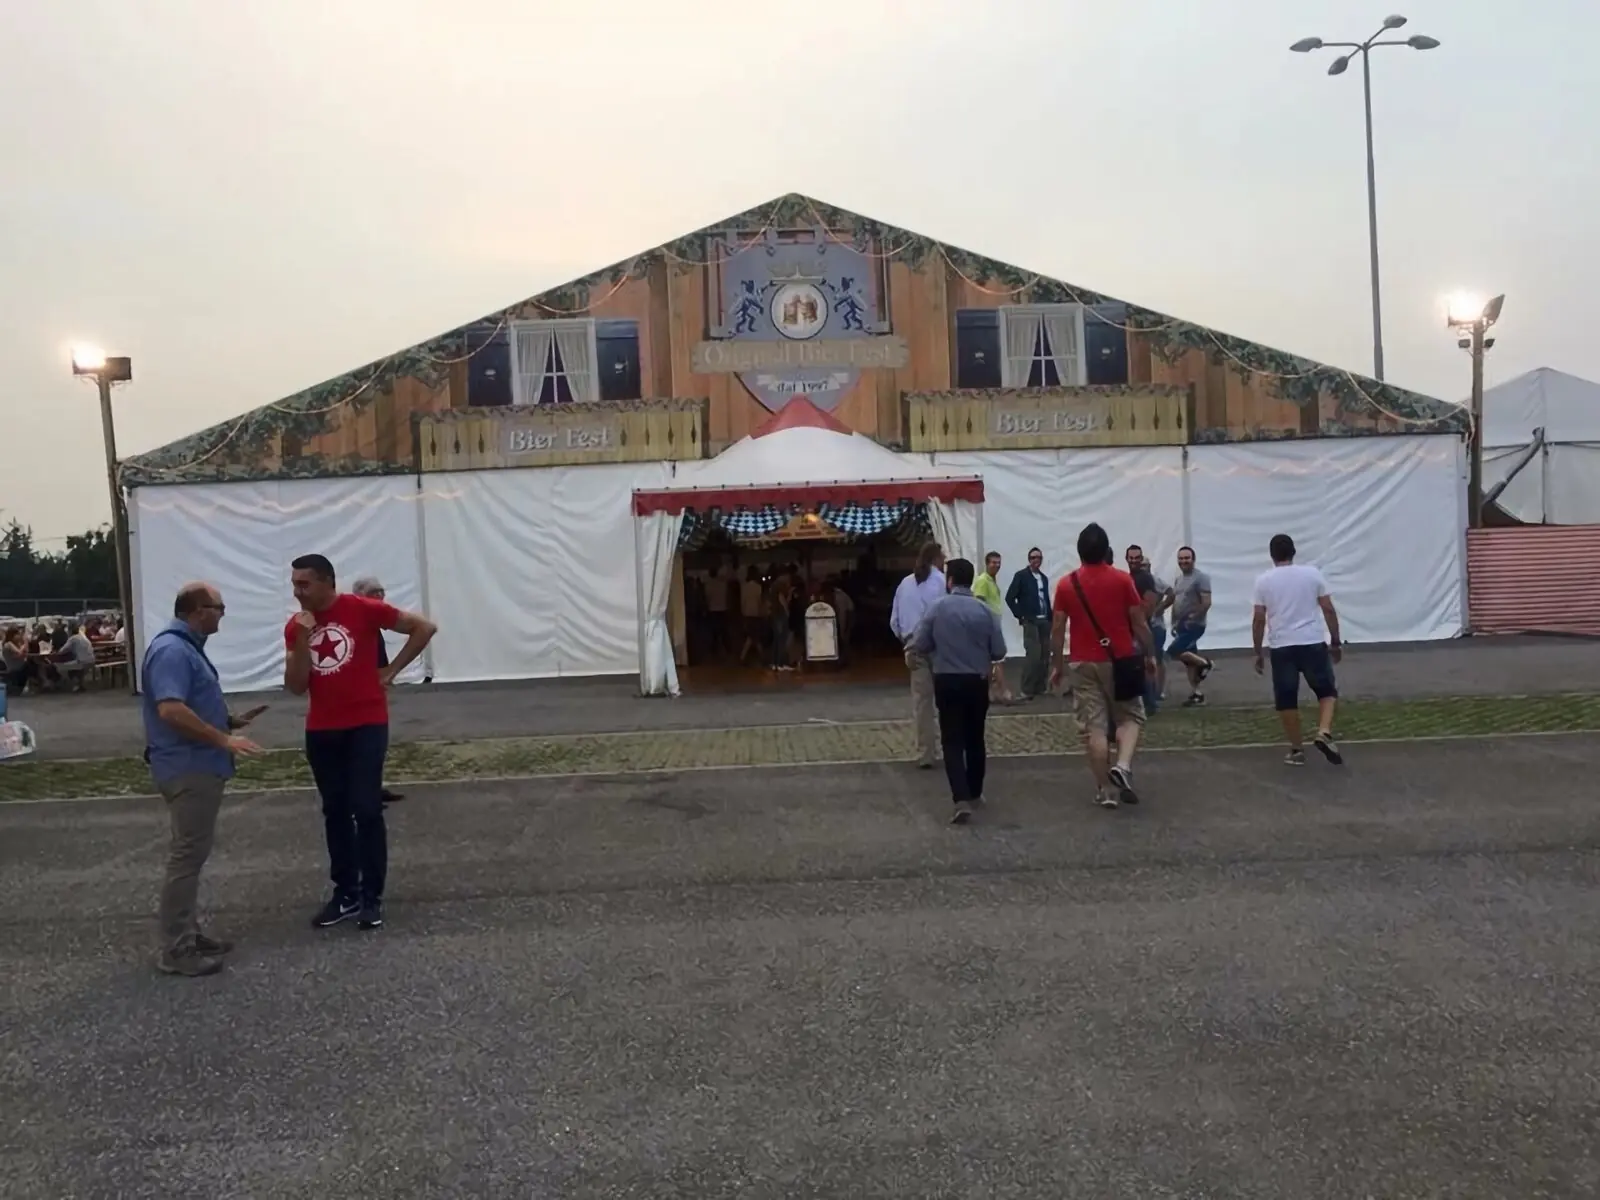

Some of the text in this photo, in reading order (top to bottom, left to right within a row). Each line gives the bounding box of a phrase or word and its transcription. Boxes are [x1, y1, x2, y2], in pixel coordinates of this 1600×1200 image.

[996, 410, 1096, 434] Bier Fest
[509, 427, 610, 451] Bier Fest
